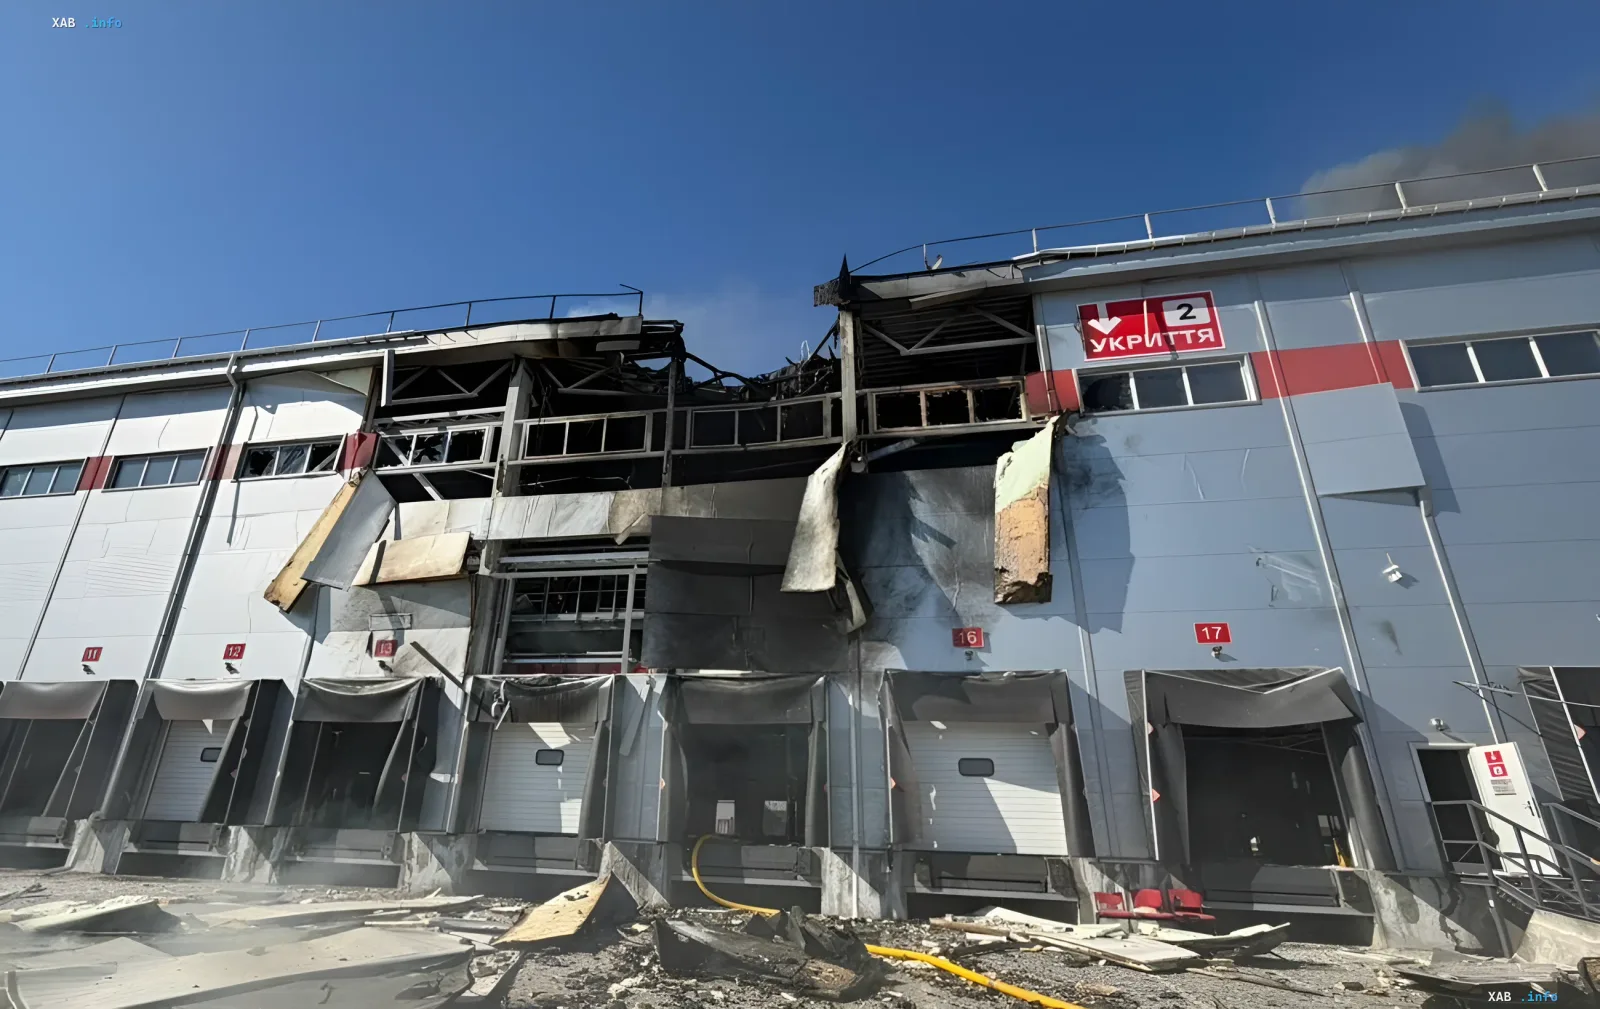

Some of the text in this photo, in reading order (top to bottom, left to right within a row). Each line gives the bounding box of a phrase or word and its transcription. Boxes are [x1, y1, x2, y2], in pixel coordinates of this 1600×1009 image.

[1176, 302, 1197, 321] 2
[1089, 328, 1216, 353] УКРИТТЯ
[959, 630, 977, 645] 16
[1201, 626, 1222, 640] 17
[87, 649, 98, 660] 11
[228, 645, 242, 657] 12
